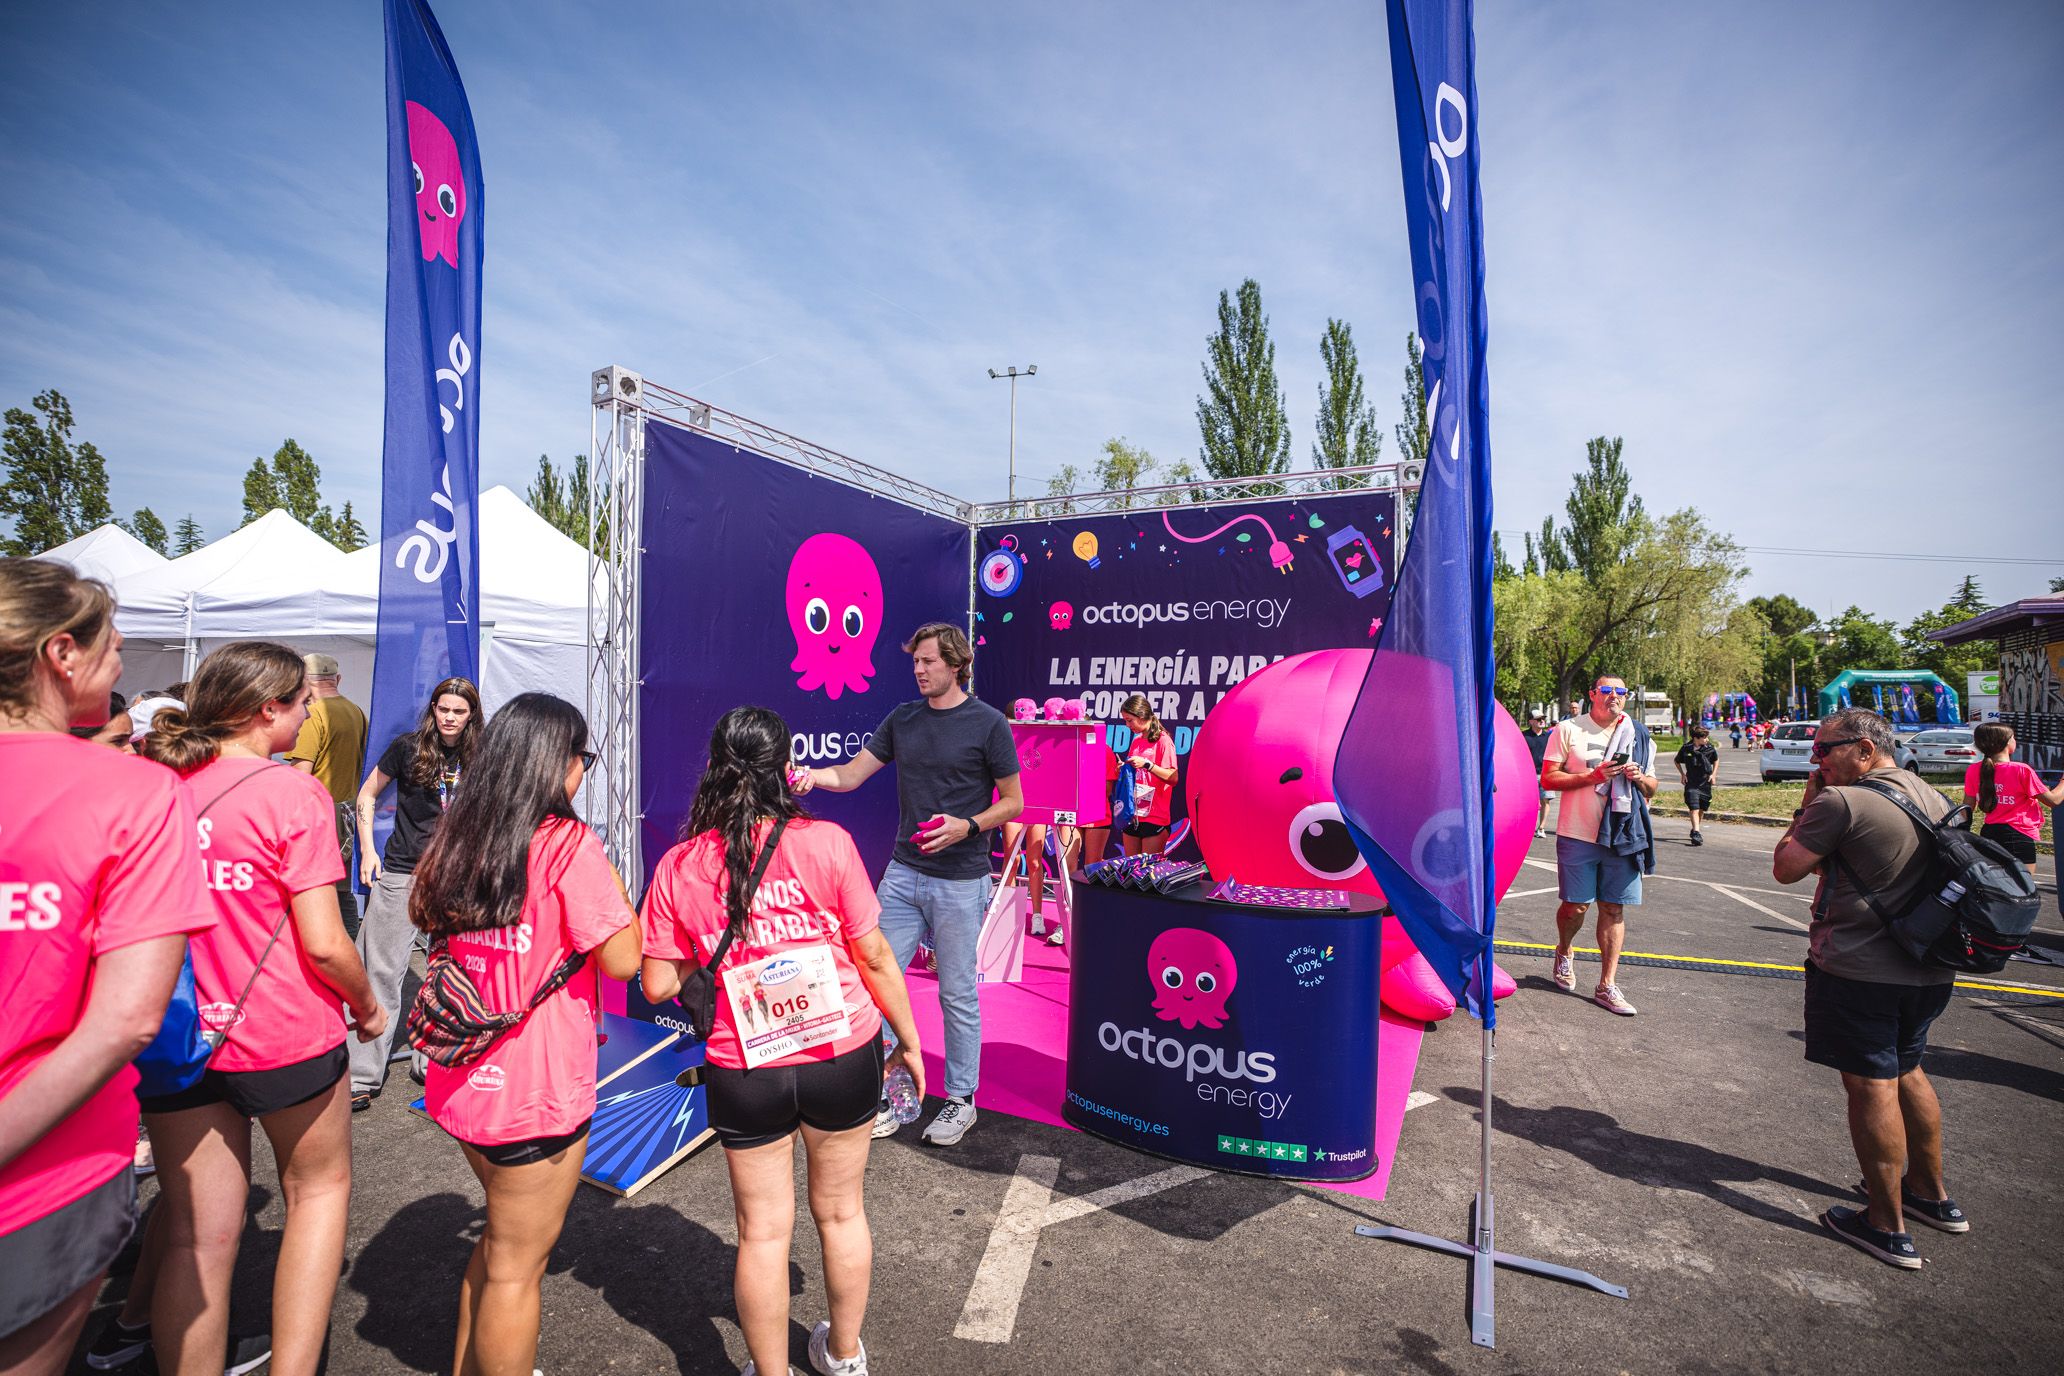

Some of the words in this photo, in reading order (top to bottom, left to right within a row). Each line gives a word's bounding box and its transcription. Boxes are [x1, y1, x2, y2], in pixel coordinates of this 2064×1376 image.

[1083, 601, 1190, 629] octopus
[1193, 598, 1292, 628] energy
[1049, 657, 1081, 685] LA
[1088, 649, 1201, 686] ENERGÍA
[1186, 691, 1206, 721] A
[1293, 959, 1322, 975] 100%
[1299, 975, 1325, 987] verde
[772, 995, 809, 1018] 016
[786, 1015, 805, 1026] 2405
[759, 1040, 793, 1058] OYSHO
[809, 1027, 838, 1041] Santander
[770, 1032, 779, 1040] DE
[1098, 1021, 1276, 1083] octopus
[1066, 1088, 1170, 1136] octopusenergy.es
[1197, 1083, 1292, 1119] energy
[1328, 1149, 1367, 1162] Trustpilot
